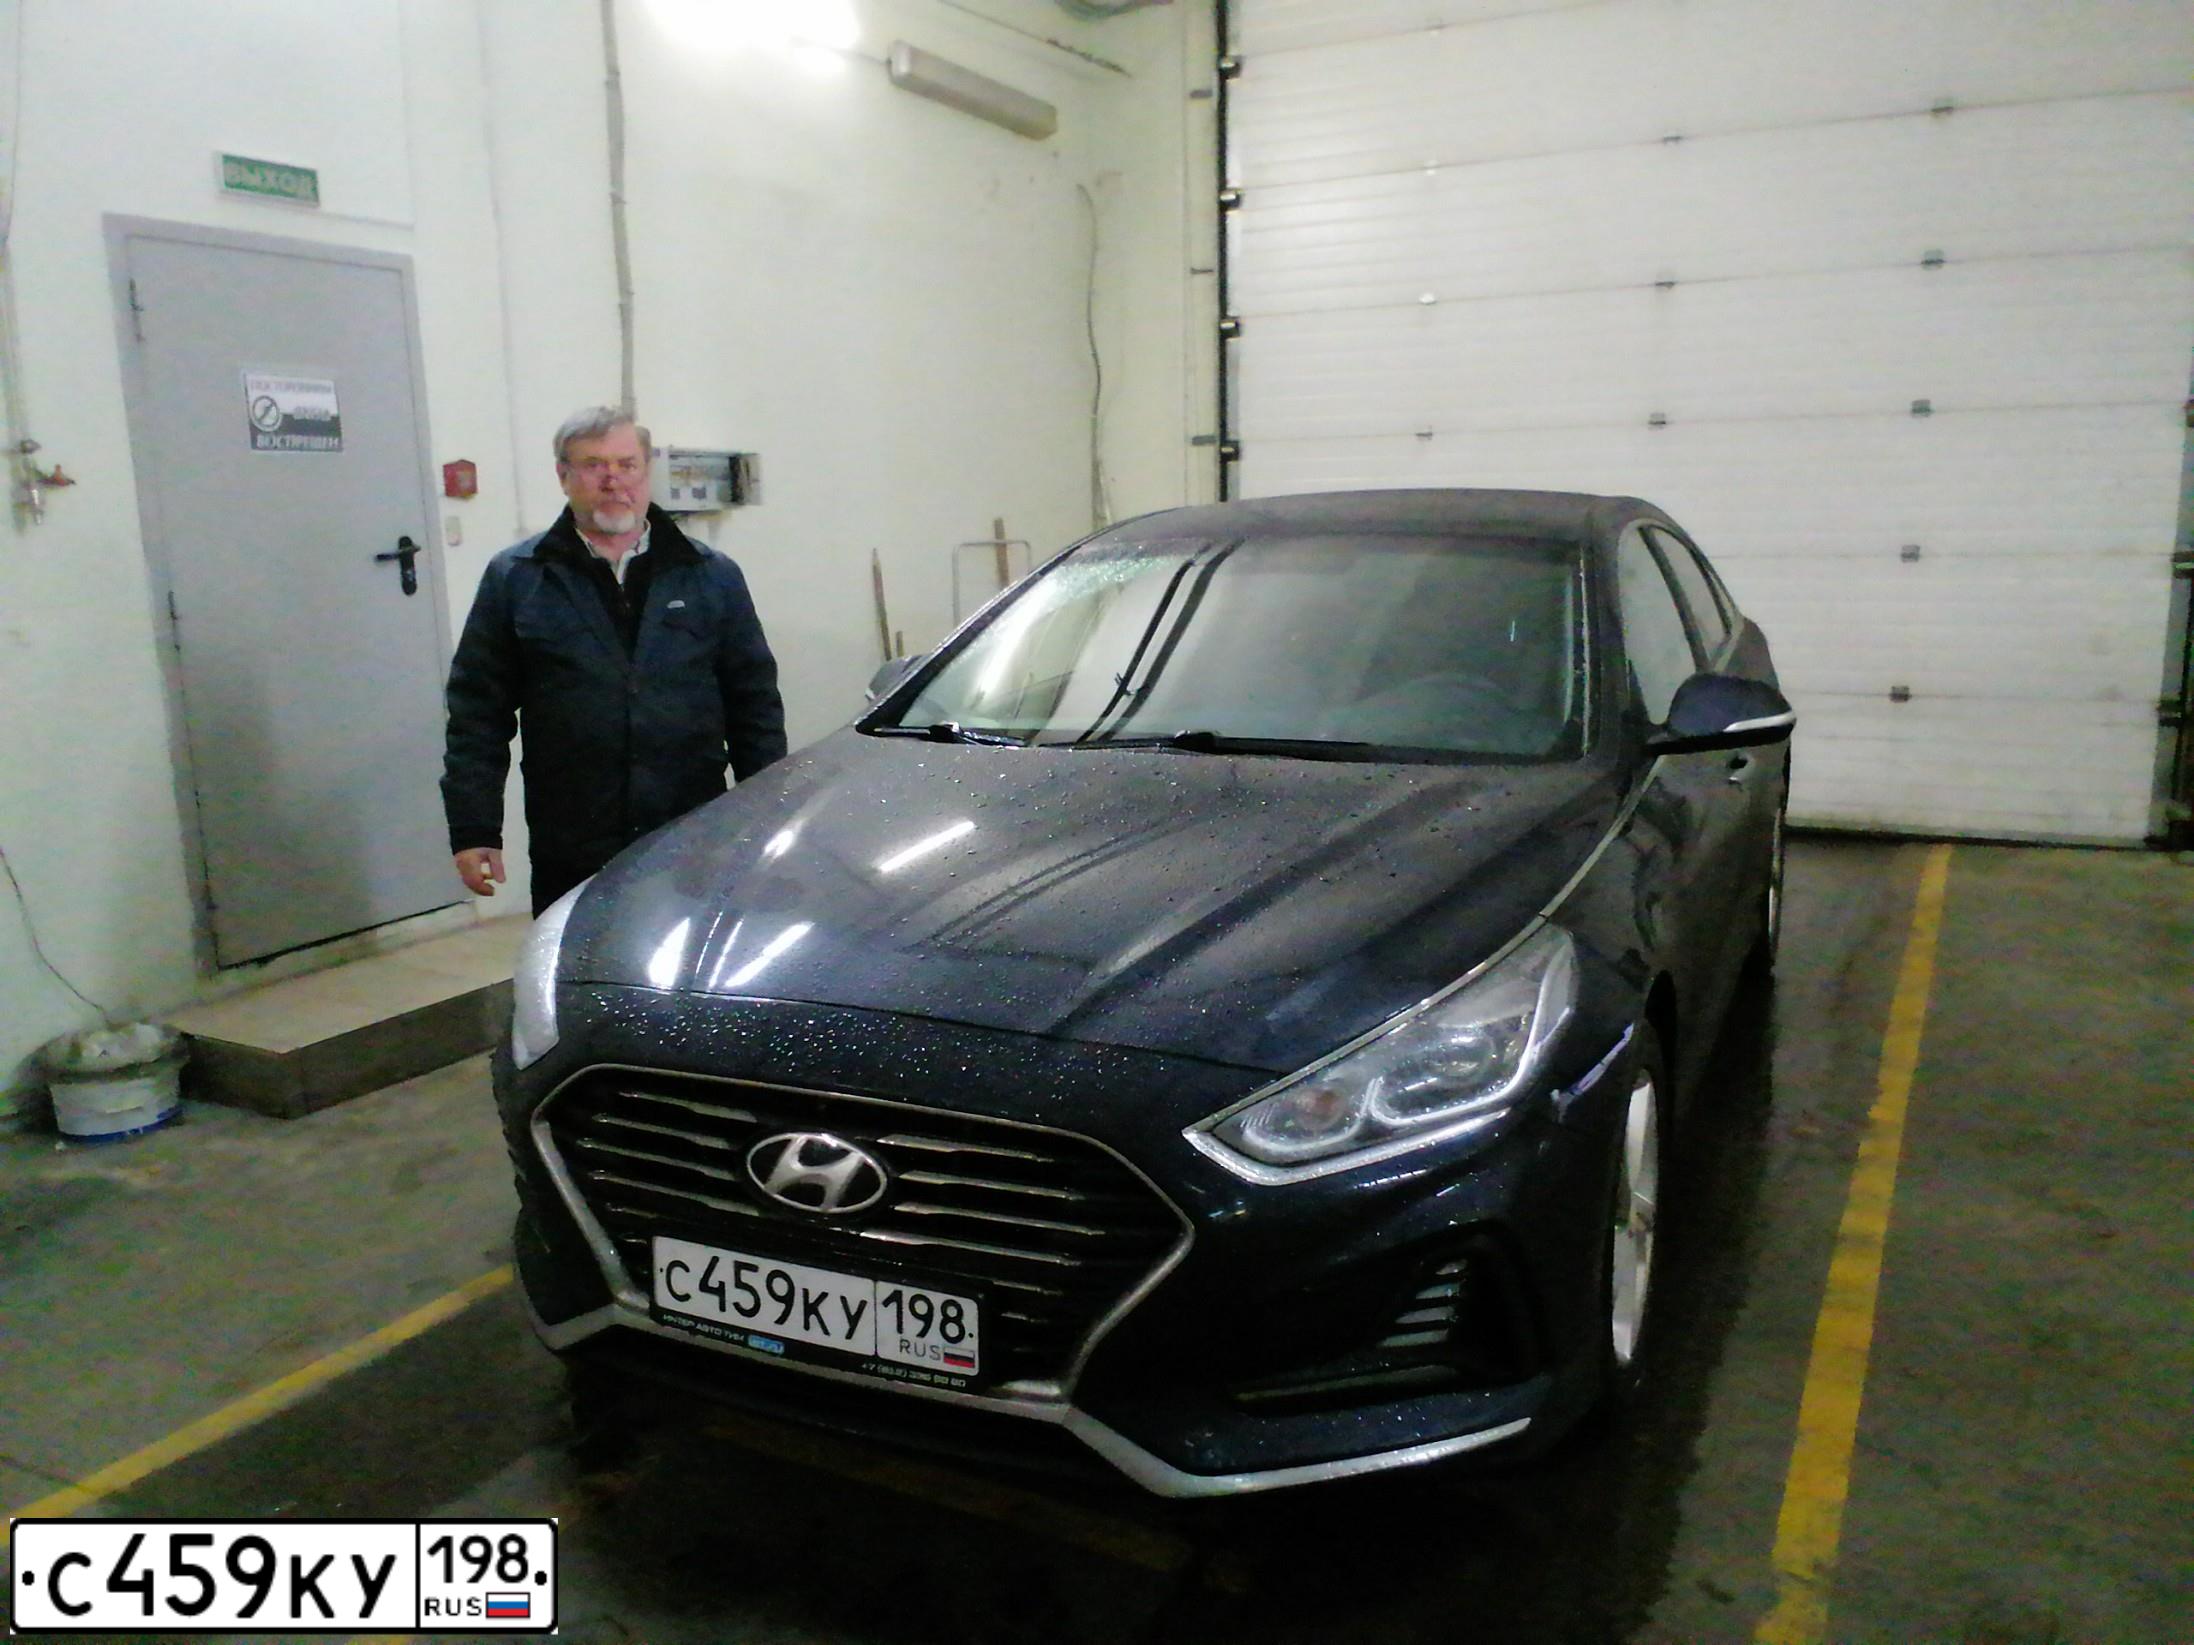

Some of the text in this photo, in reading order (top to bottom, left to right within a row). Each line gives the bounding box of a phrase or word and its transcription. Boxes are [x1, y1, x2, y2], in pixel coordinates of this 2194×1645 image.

[665, 1255, 965, 1344] С459КУ 198
[899, 1338, 941, 1361] RUS
